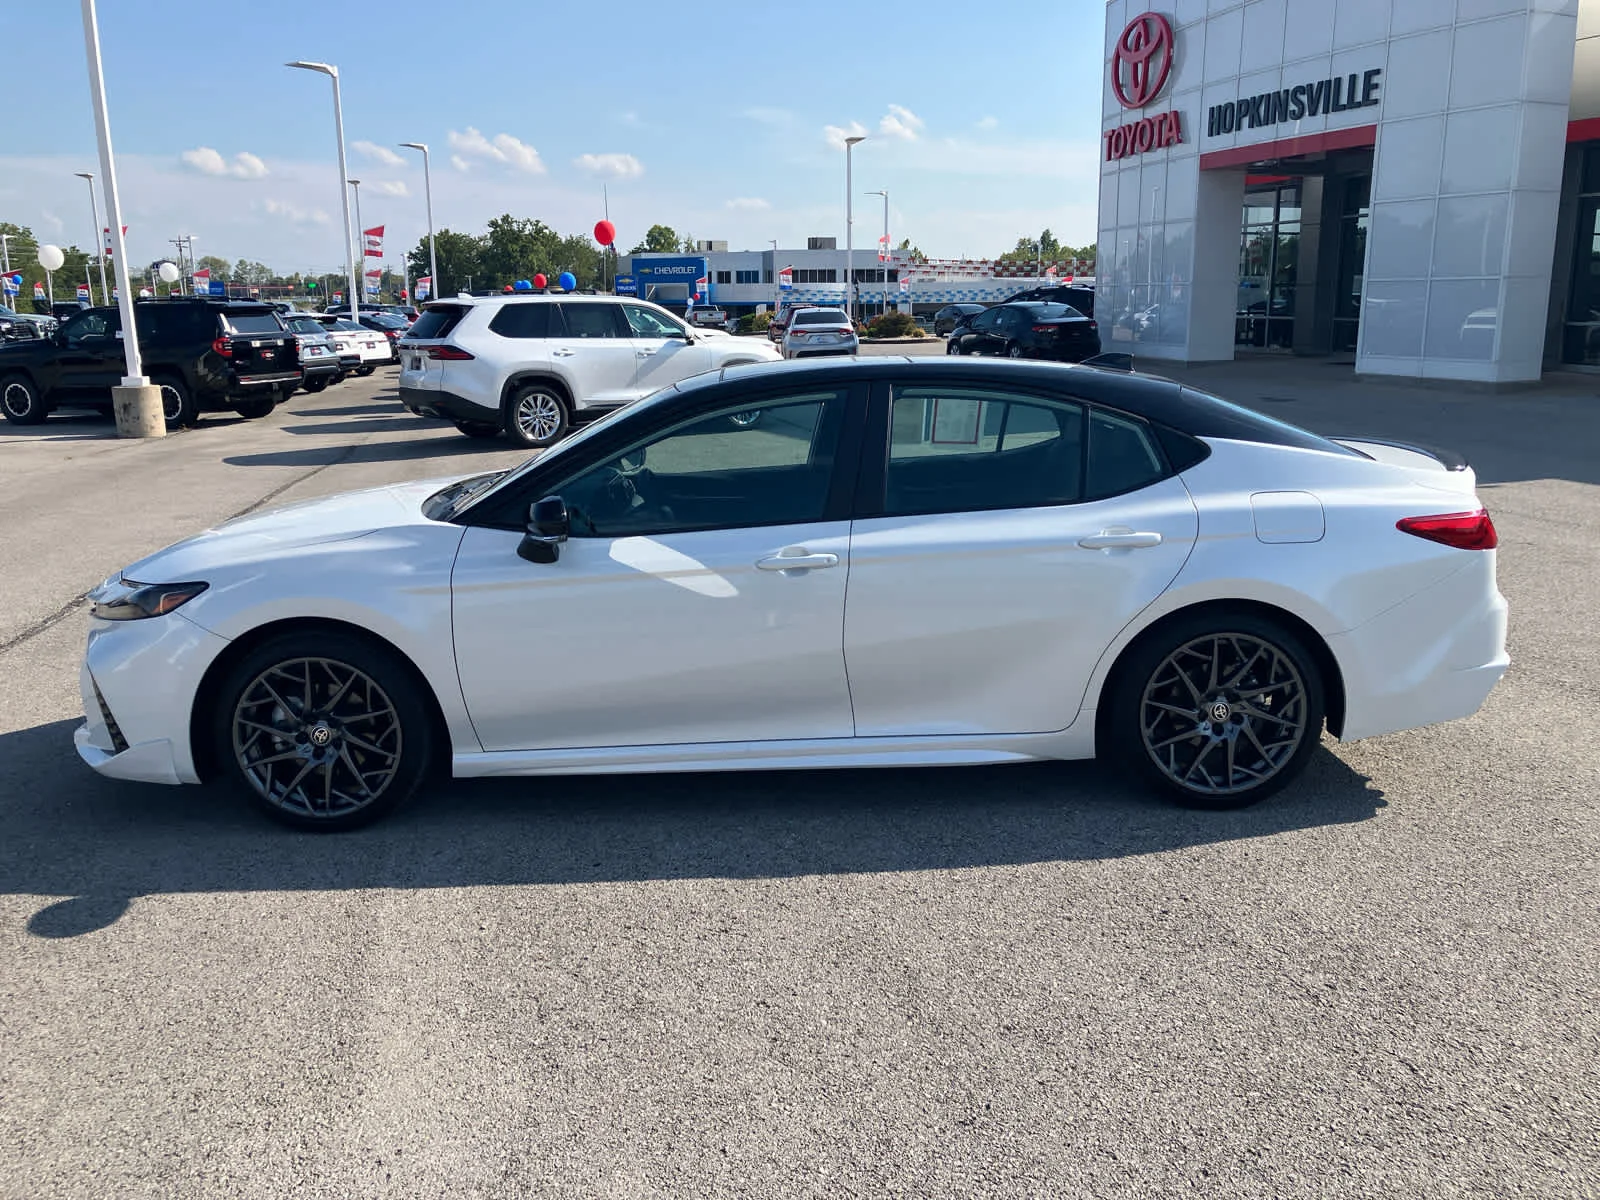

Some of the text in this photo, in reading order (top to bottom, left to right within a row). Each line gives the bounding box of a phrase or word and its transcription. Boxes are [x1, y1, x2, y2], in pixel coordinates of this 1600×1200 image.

[1207, 68, 1381, 137] HOPKINSVILLE
[1104, 110, 1183, 161] TOYOTA
[654, 266, 697, 274] CHEVROLET
